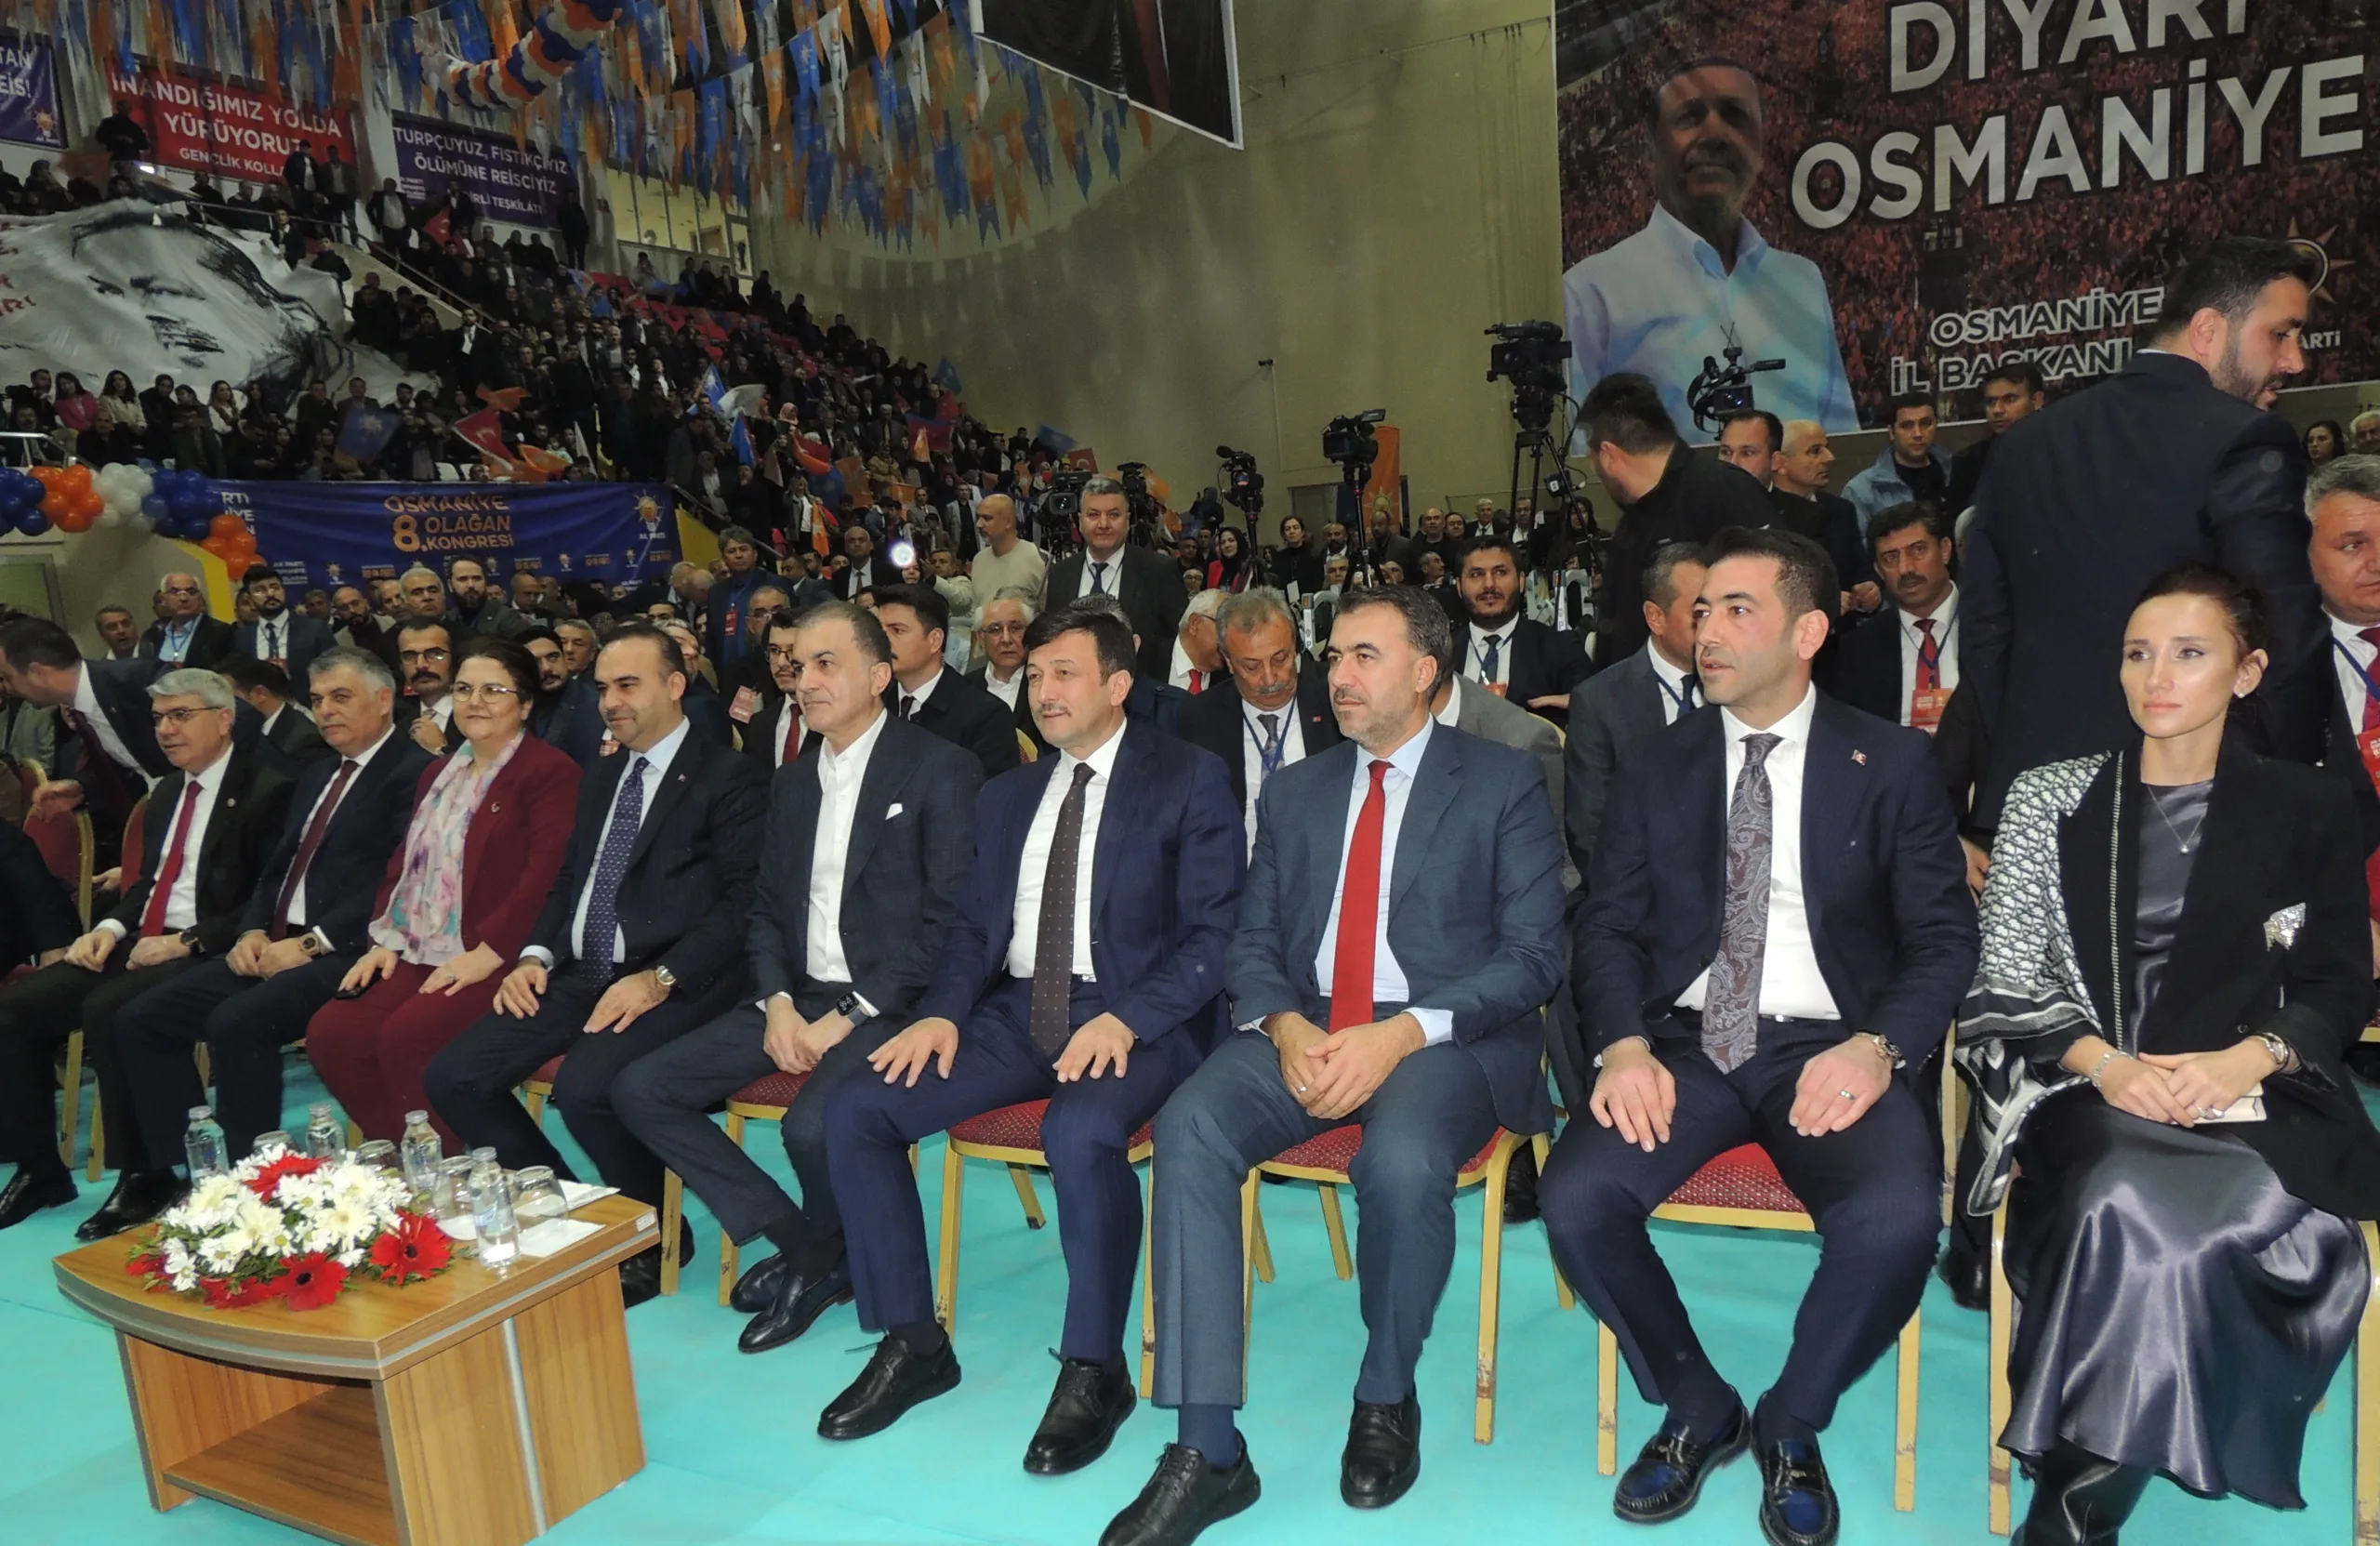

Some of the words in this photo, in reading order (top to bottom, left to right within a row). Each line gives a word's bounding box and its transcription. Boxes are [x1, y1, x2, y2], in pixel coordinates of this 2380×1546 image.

[269, 104, 342, 138] YOLDA
[392, 126, 488, 160] TURPÇUYUZ,
[1792, 55, 2364, 229] OSMANİYE
[414, 152, 488, 180] ÖLÜMÜNE
[1930, 286, 2164, 347] OSMANİYE
[1890, 356, 1930, 396] İL
[384, 491, 509, 512] OSMANİYE
[425, 513, 510, 534] OLAĞAN
[426, 534, 514, 550] KONGRESİ
